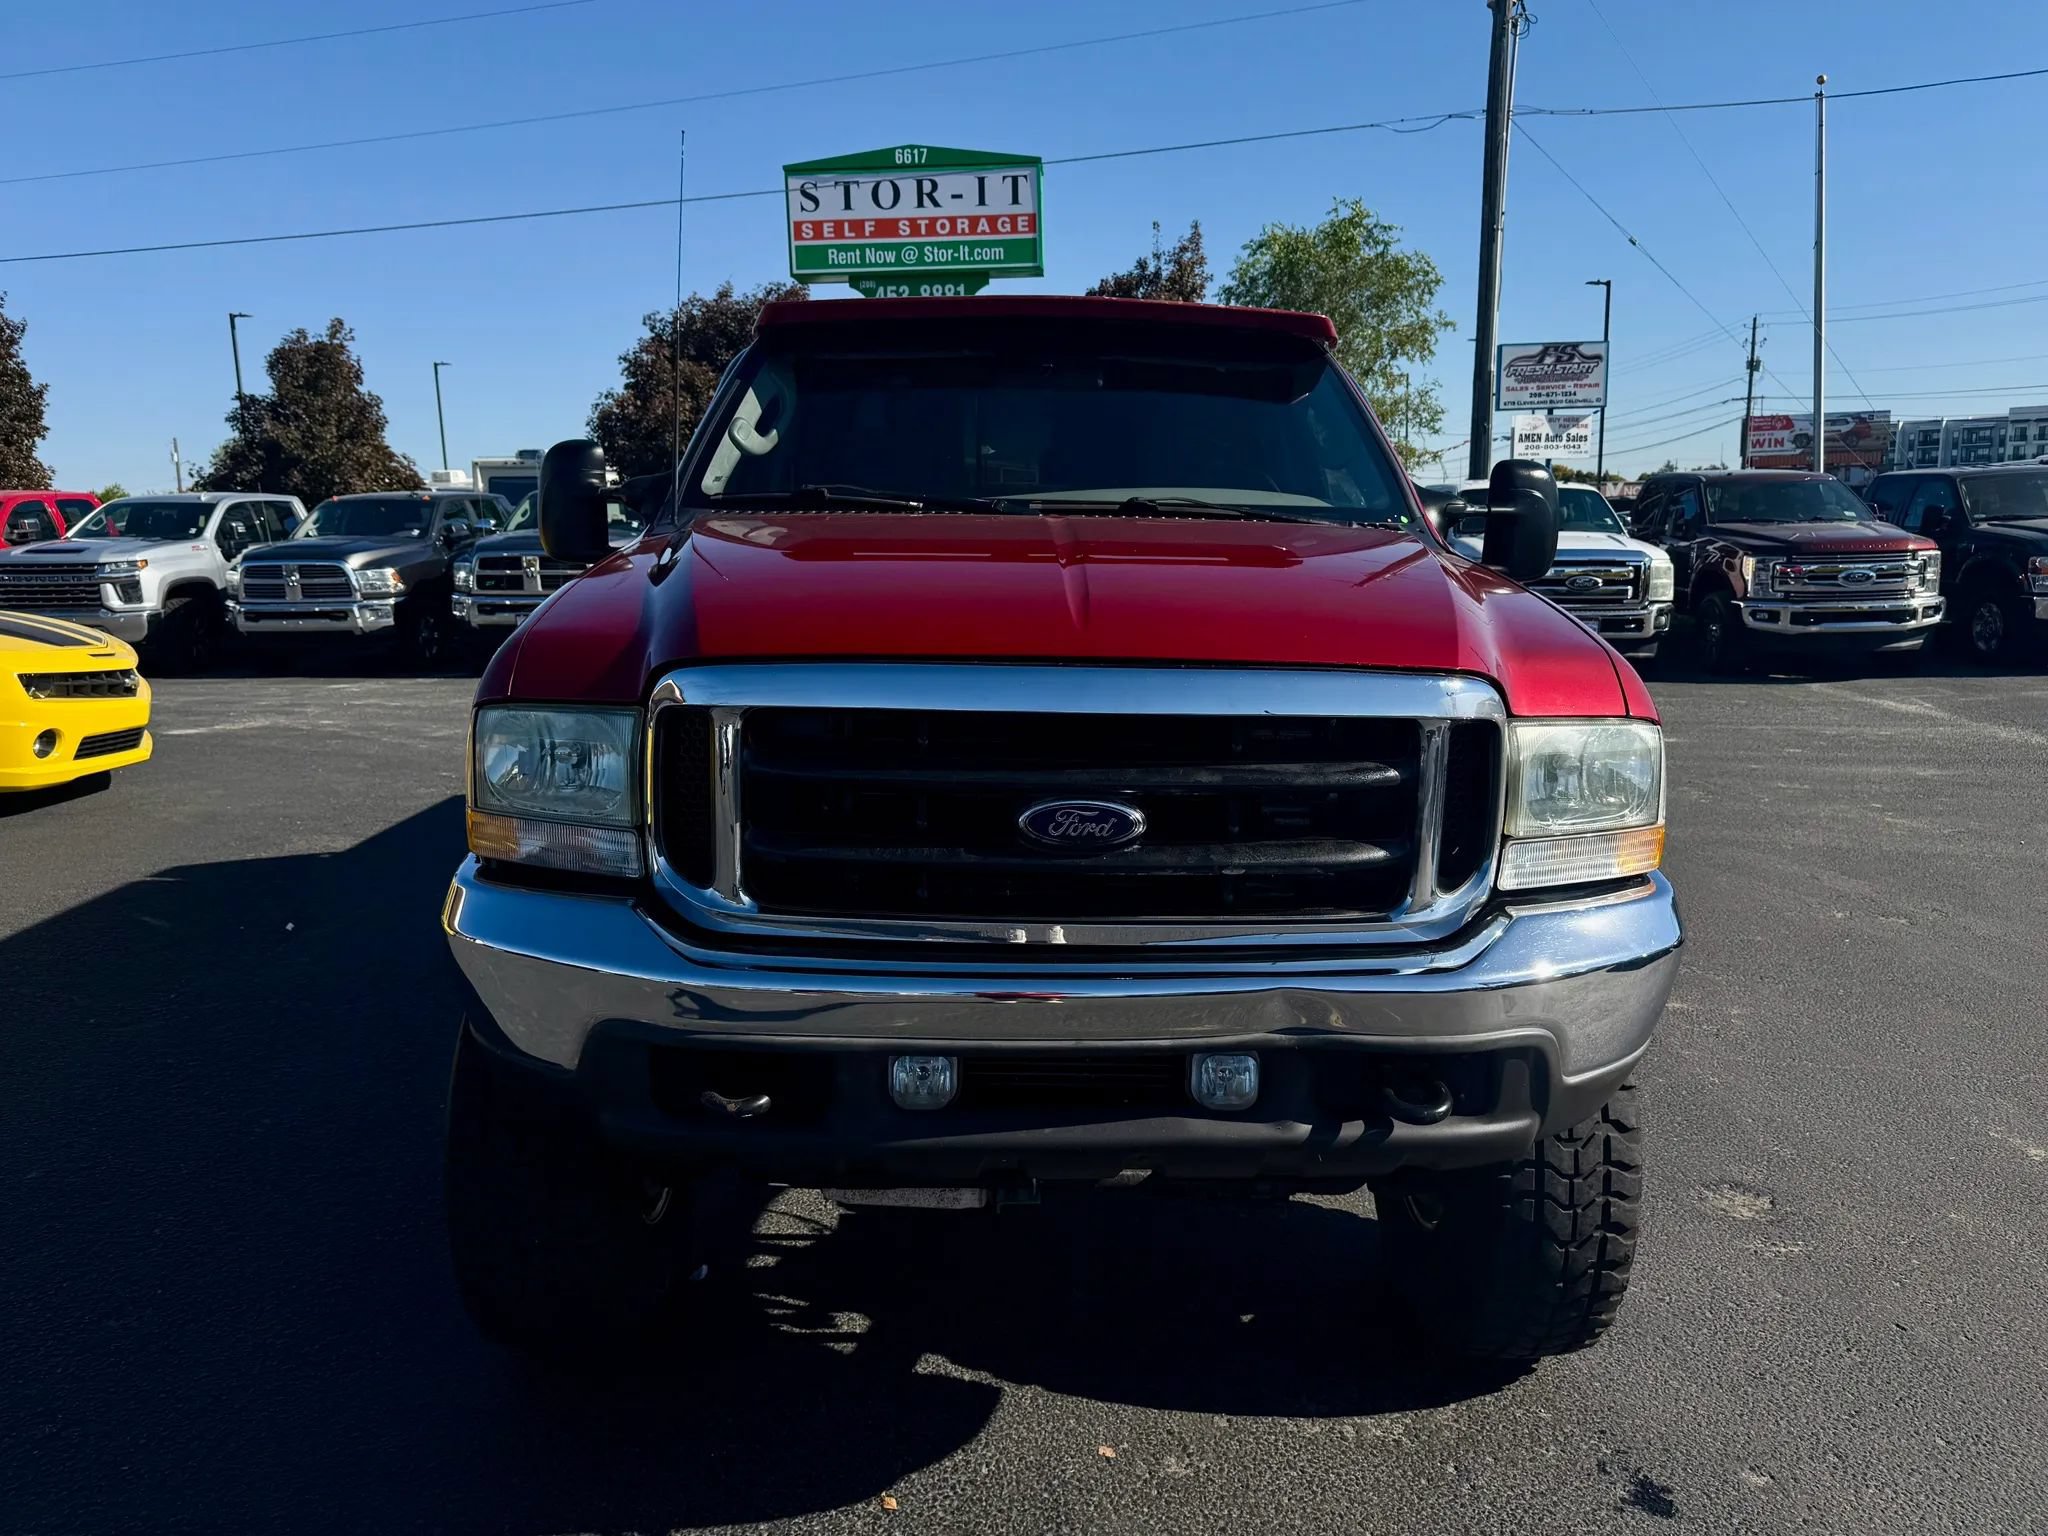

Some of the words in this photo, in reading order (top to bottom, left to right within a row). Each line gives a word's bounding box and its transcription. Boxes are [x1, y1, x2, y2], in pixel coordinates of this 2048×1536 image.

[895, 148, 927, 164] 6617
[800, 174, 1028, 213] STOR-IT
[801, 221, 876, 239] SELF
[898, 216, 1029, 236] STORAGE
[828, 248, 861, 265] Rent
[866, 247, 896, 264] Now
[901, 246, 919, 264] @
[924, 245, 1004, 263] Stor-It.com
[1506, 363, 1554, 378] FRESH
[1554, 361, 1599, 375] START
[1518, 432, 1542, 443] AMEN
[1544, 433, 1563, 443] Auto
[1565, 432, 1588, 443] Sales
[1751, 437, 1784, 449] WIN
[1049, 809, 1118, 837] Ford
